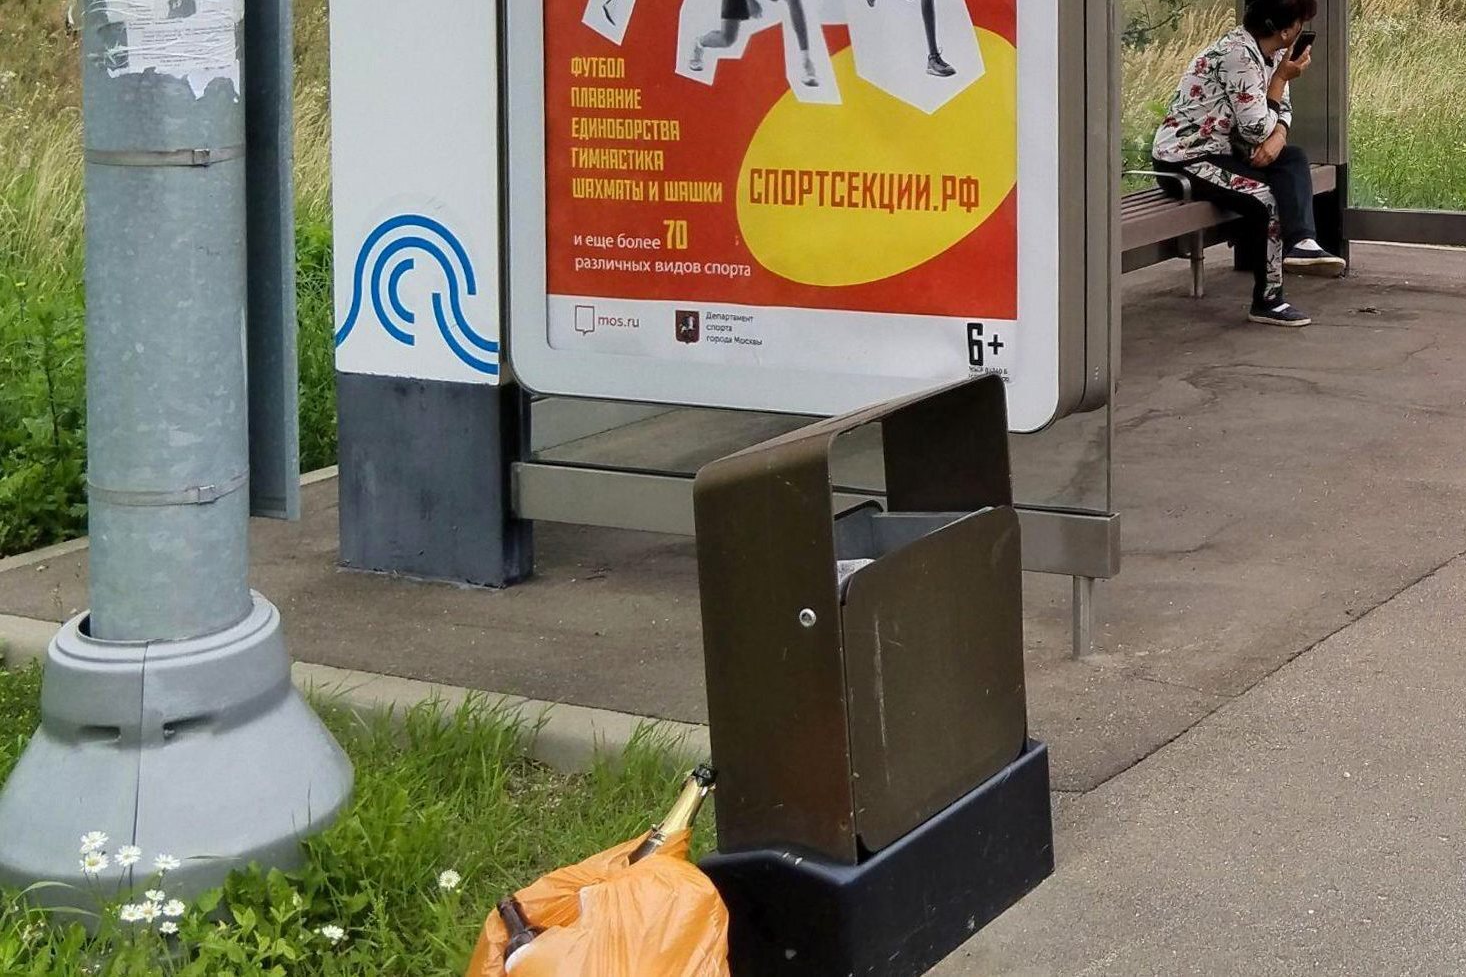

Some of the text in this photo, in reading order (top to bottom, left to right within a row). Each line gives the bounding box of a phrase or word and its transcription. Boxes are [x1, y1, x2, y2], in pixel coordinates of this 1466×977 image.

[571, 56, 625, 78] ФУТБОЛ
[571, 87, 642, 110] ПЛАВАНИЕ
[571, 117, 680, 141] ЕДИНОБОРСТВА
[571, 147, 664, 171] ГИМНАСТИКА
[572, 178, 723, 203] ШАХМАТЫ И ШАШКИ
[750, 168, 980, 214] СПОРТСЕКЦИИ.РФ
[573, 220, 688, 250] и еще более 70
[575, 257, 751, 278] различных видов спорта
[598, 316, 640, 328] mos.ru
[705, 311, 754, 323] Департамент
[706, 324, 733, 334] спорта
[967, 322, 1004, 367] 6+
